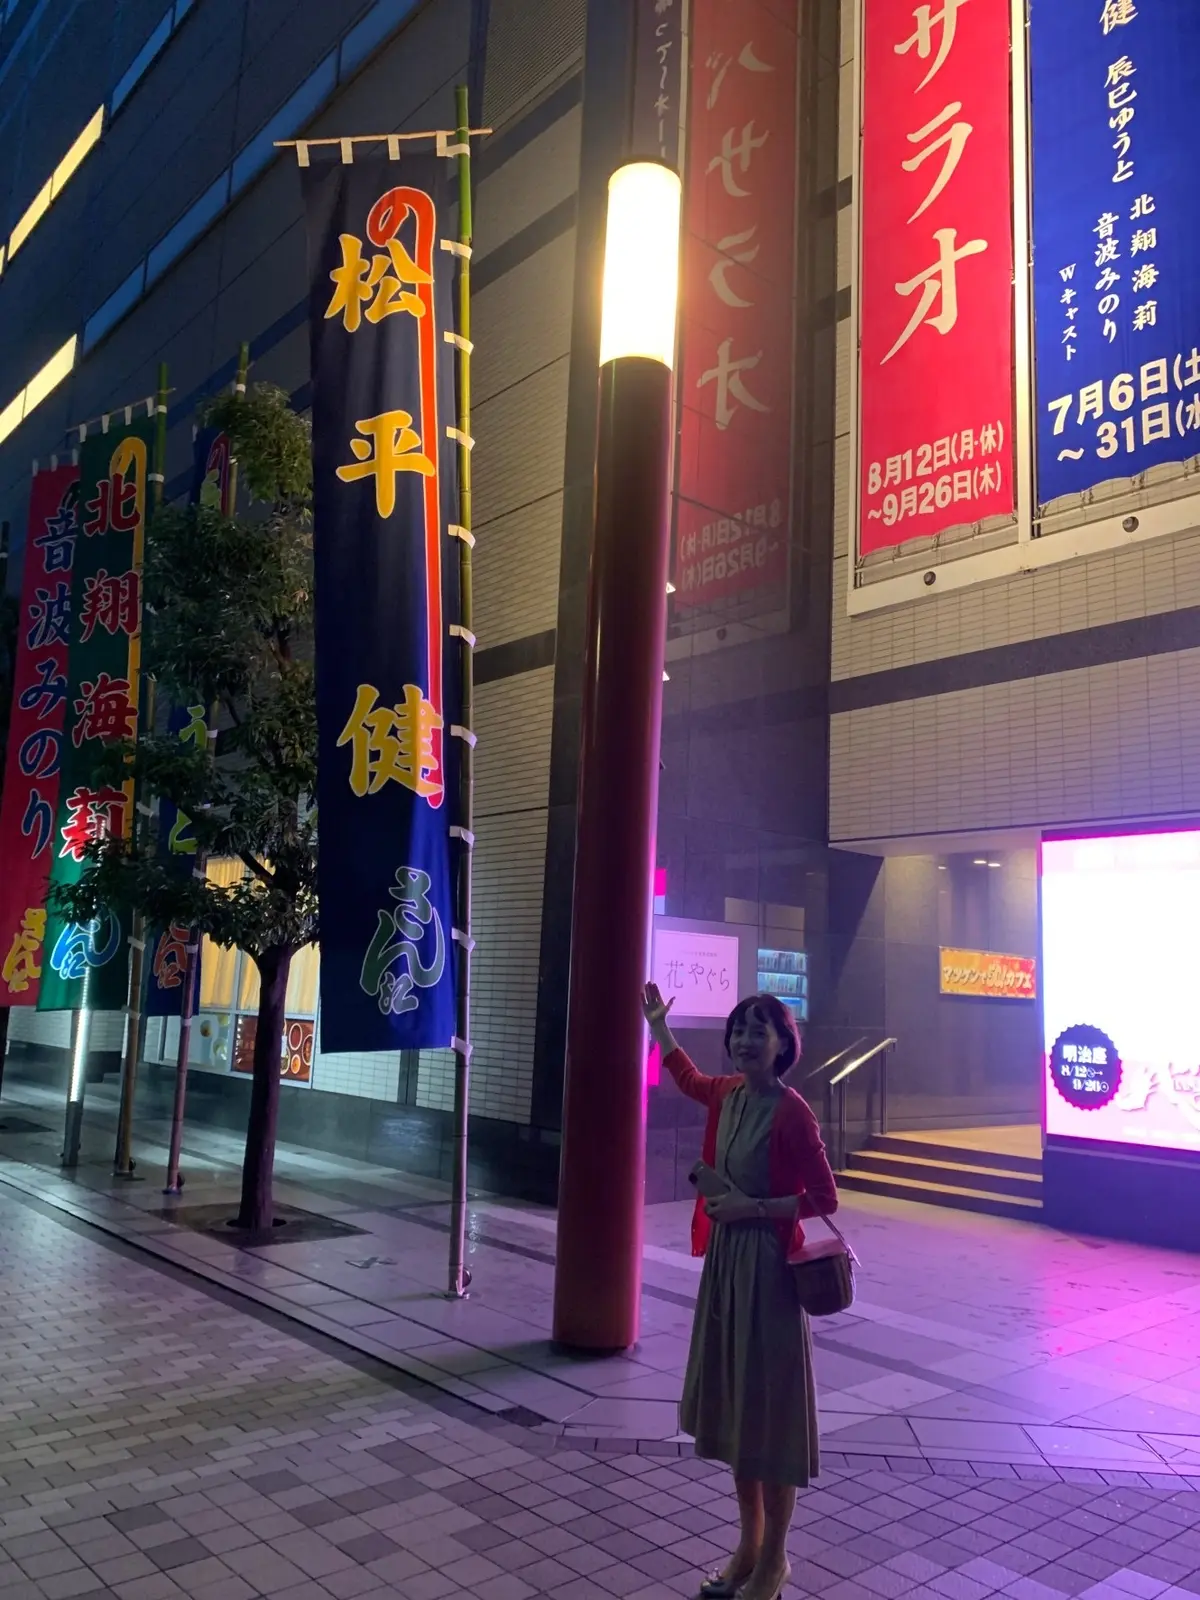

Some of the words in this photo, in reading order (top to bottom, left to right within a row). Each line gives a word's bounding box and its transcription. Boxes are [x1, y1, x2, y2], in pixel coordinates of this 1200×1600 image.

[1104, 55, 1138, 183] 辰巳ゆうと
[1060, 263, 1078, 361] Wキャスト
[1092, 212, 1122, 344] 音波みのり
[1130, 193, 1160, 332] 北翔海莉
[664, 959, 731, 992] 花やぐら
